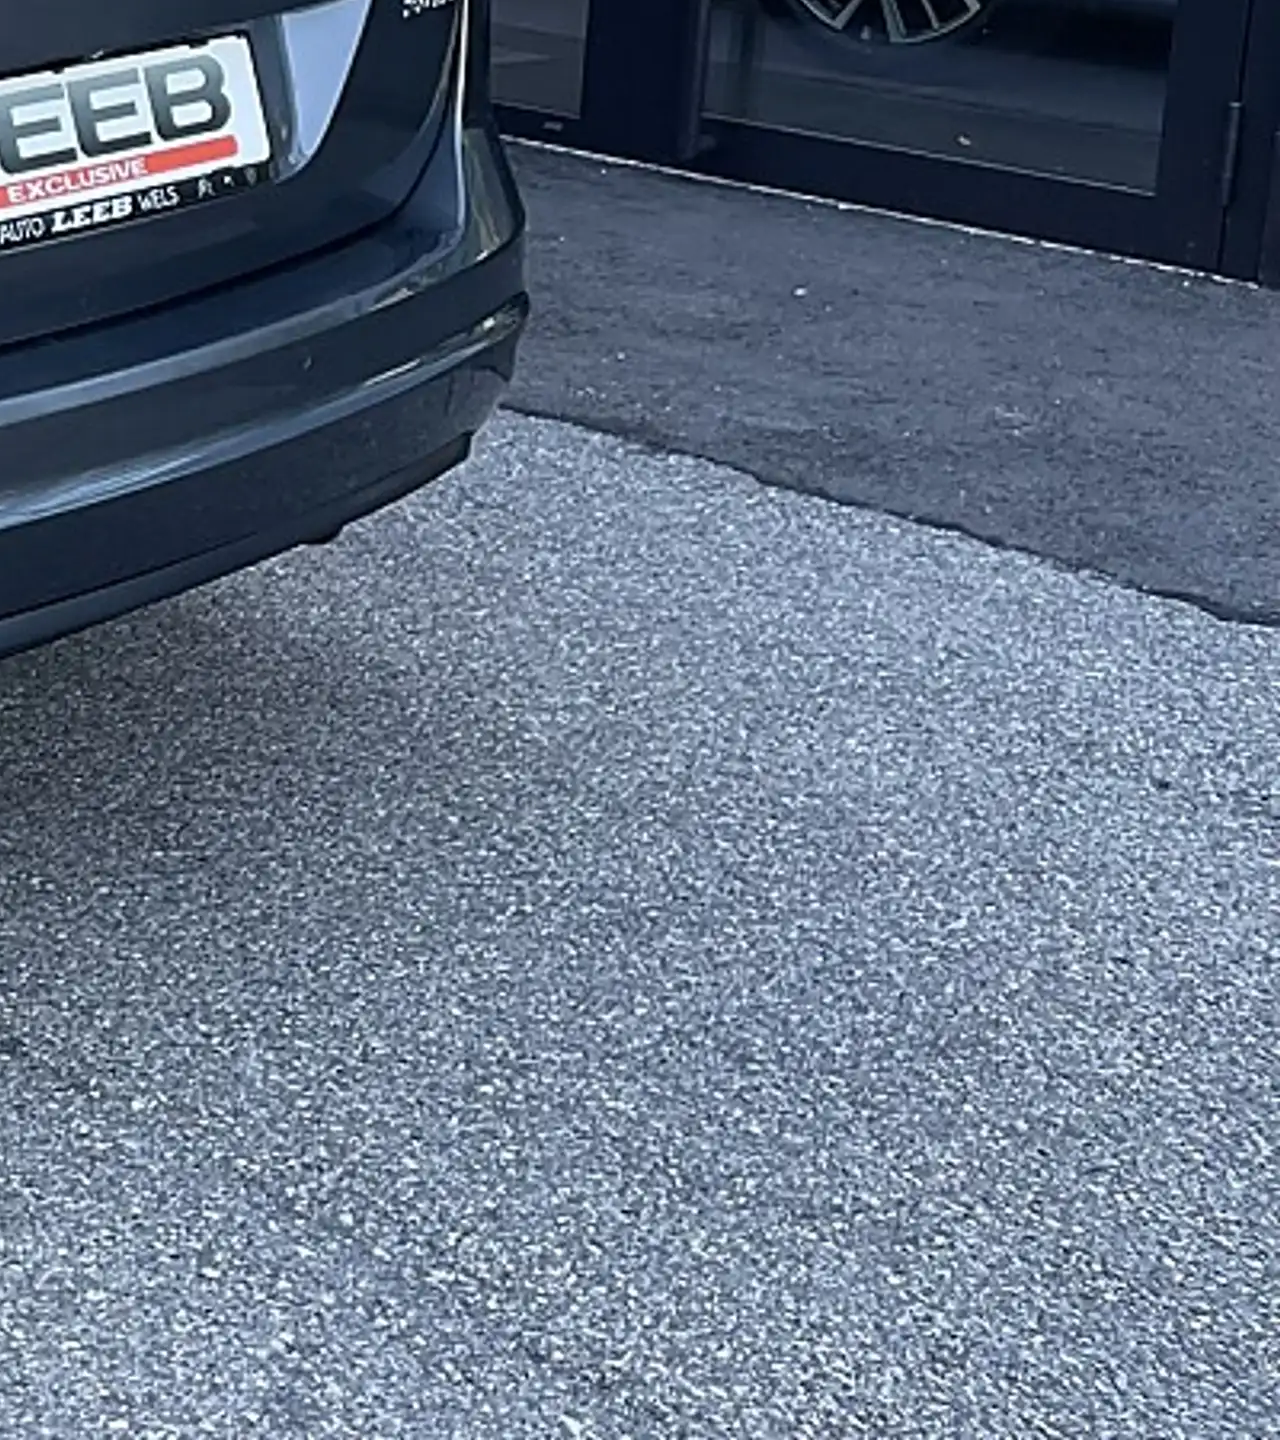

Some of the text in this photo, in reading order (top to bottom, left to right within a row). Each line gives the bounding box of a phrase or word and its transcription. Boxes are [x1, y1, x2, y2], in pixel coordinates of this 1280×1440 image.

[6, 157, 149, 204] EXCLUSIVE
[0, 184, 181, 245] AUTO LEEB WELS
